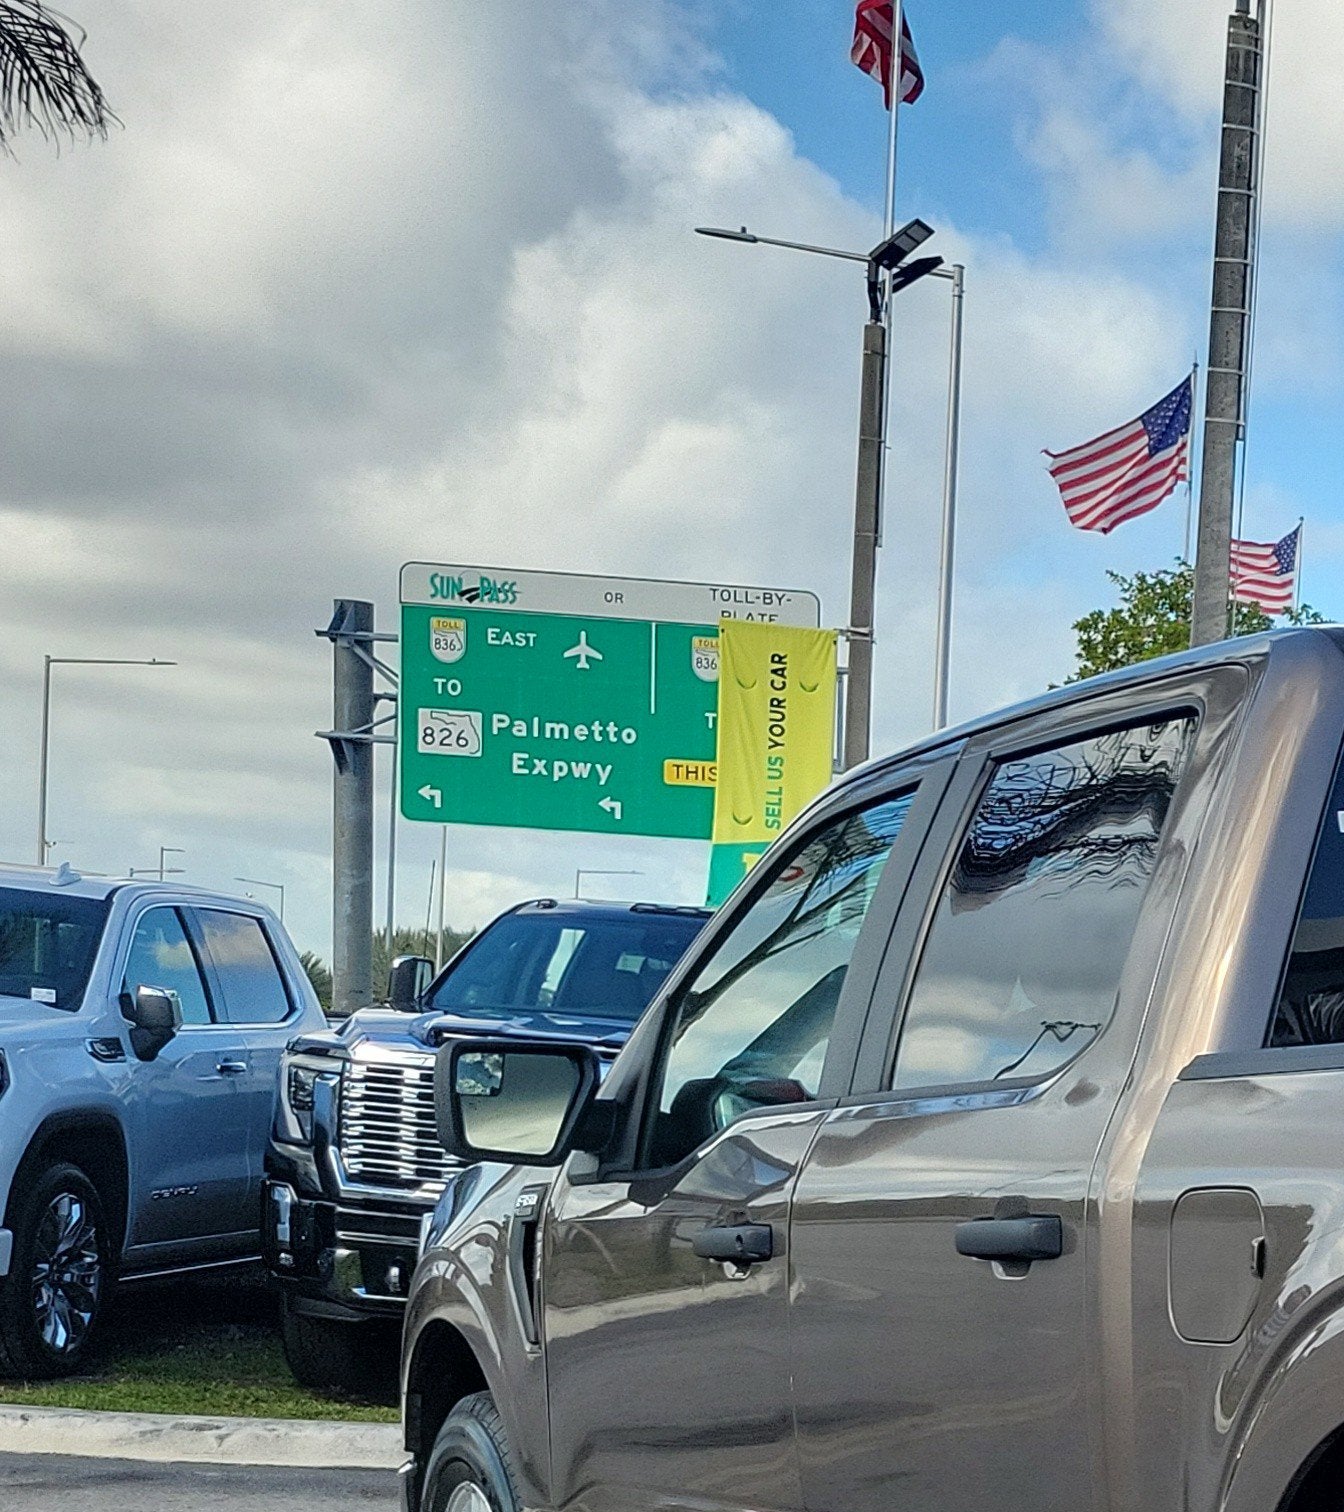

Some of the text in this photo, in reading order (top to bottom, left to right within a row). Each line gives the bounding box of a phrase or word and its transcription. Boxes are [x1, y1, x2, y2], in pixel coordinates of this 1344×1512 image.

[604, 592, 624, 604] OR
[709, 588, 792, 606] TOLL-BY-
[436, 620, 459, 629] TOLL
[434, 637, 456, 651] 836
[487, 628, 537, 647] EAST
[696, 657, 718, 670] 836
[433, 677, 462, 696] TO
[705, 712, 717, 729] T
[422, 713, 637, 748] 826 Palmetto
[765, 653, 788, 830] SELL US YOUR CAR
[512, 752, 613, 785] Expwy
[672, 764, 717, 782] THIS
